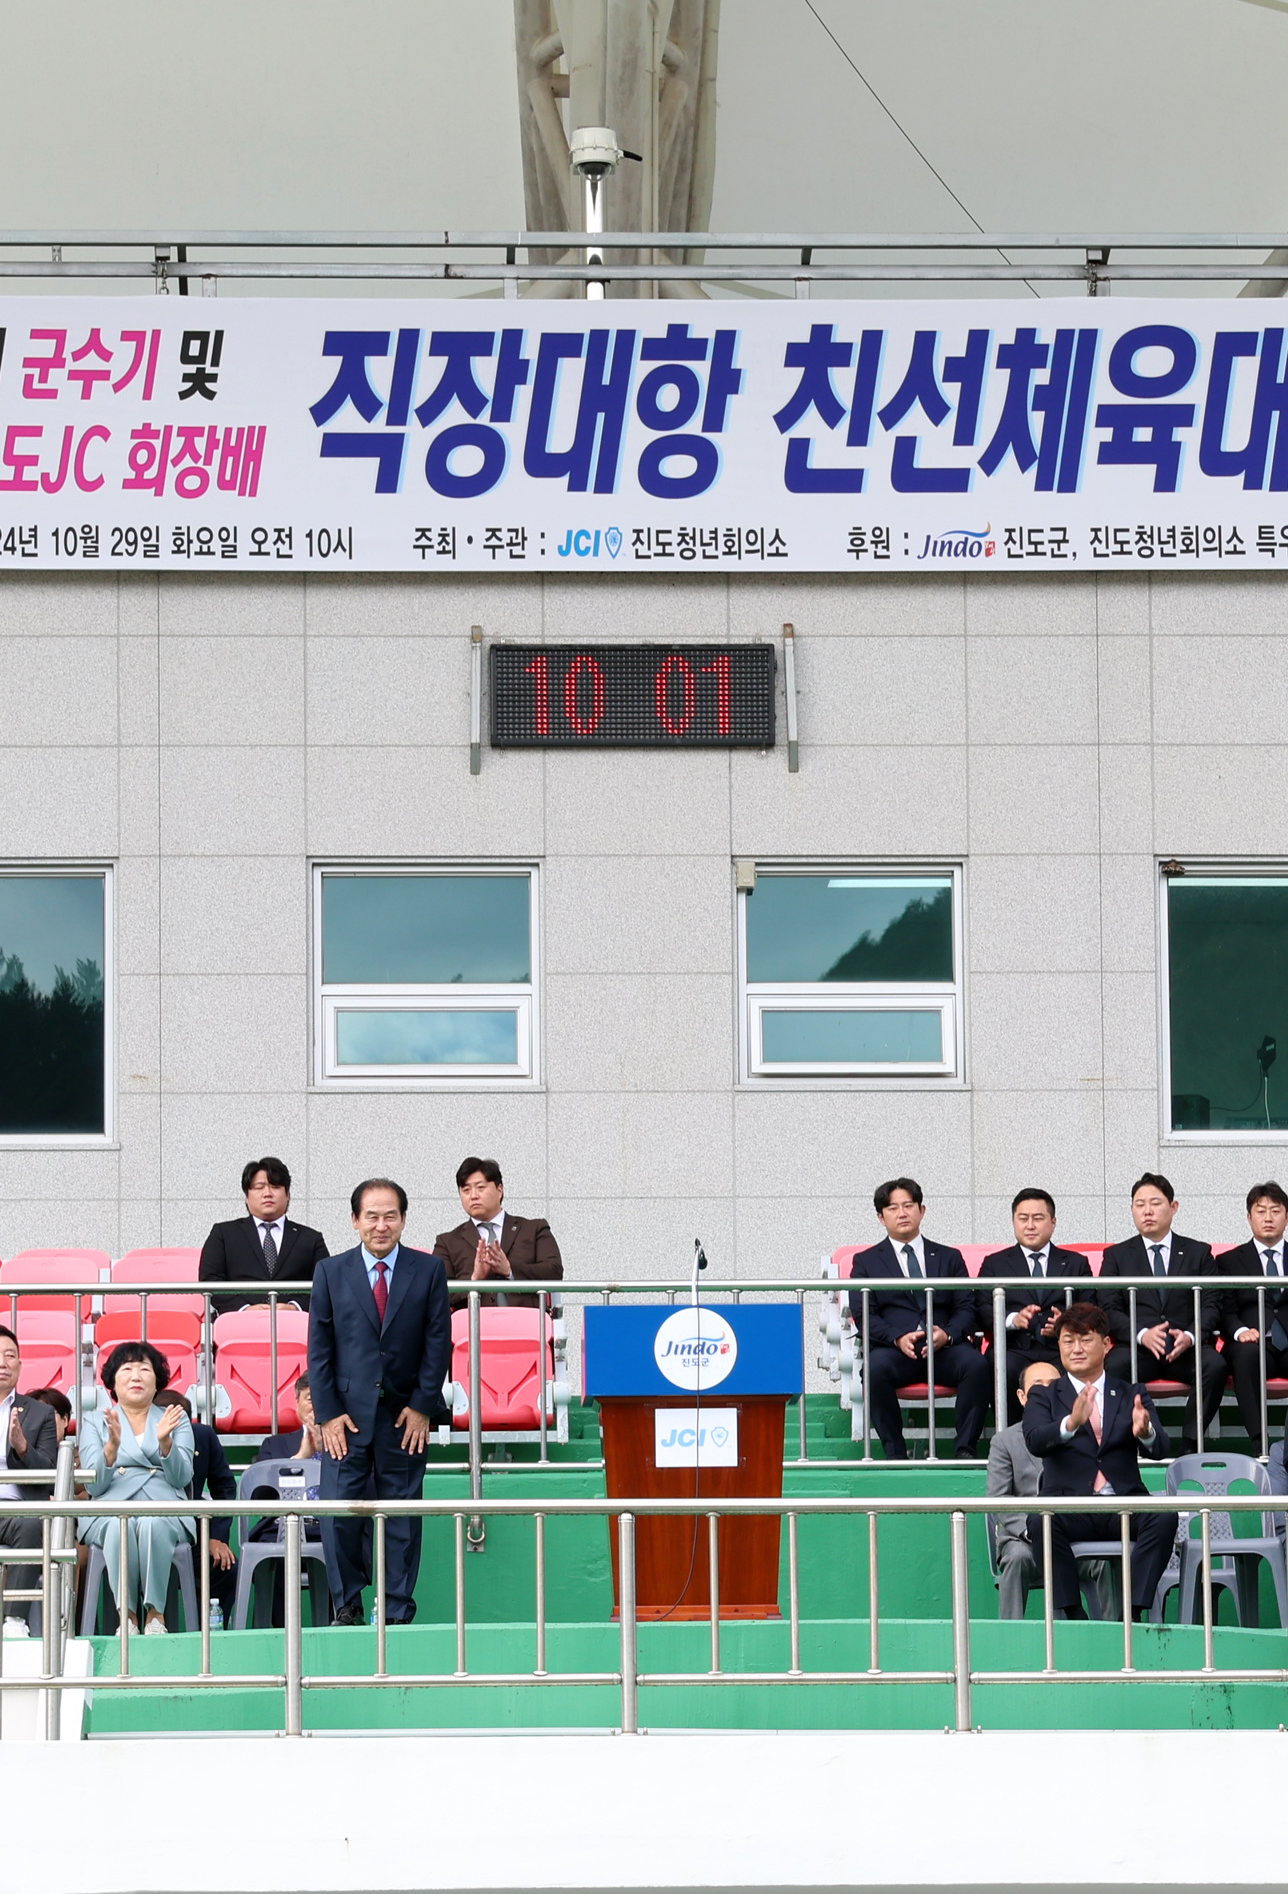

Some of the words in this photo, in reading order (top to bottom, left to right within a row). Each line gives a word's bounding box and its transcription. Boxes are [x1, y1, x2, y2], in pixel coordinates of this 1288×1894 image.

[22, 328, 161, 400] 군수기
[178, 330, 224, 401] 및
[309, 324, 742, 499] 직장대항
[122, 423, 266, 499] 회장배
[52, 524, 99, 558] 10월
[111, 526, 160, 558] 29일
[171, 526, 237, 559] 화요일
[249, 526, 293, 558] 오전
[306, 527, 352, 559] 10시
[413, 527, 456, 559] 주최
[483, 527, 527, 559] 주관
[558, 529, 600, 557] JCI
[632, 527, 788, 560] 진도청년회의소
[847, 527, 890, 560] 후원
[917, 535, 983, 559] Jindo
[1004, 526, 1076, 560] 진도군,
[1090, 525, 1246, 558] 진도청년회의소
[525, 656, 604, 734] 10
[656, 656, 730, 734] 01
[661, 1341, 718, 1357] Jindo
[681, 1358, 710, 1367] 진도군
[661, 1428, 707, 1448] JCI
